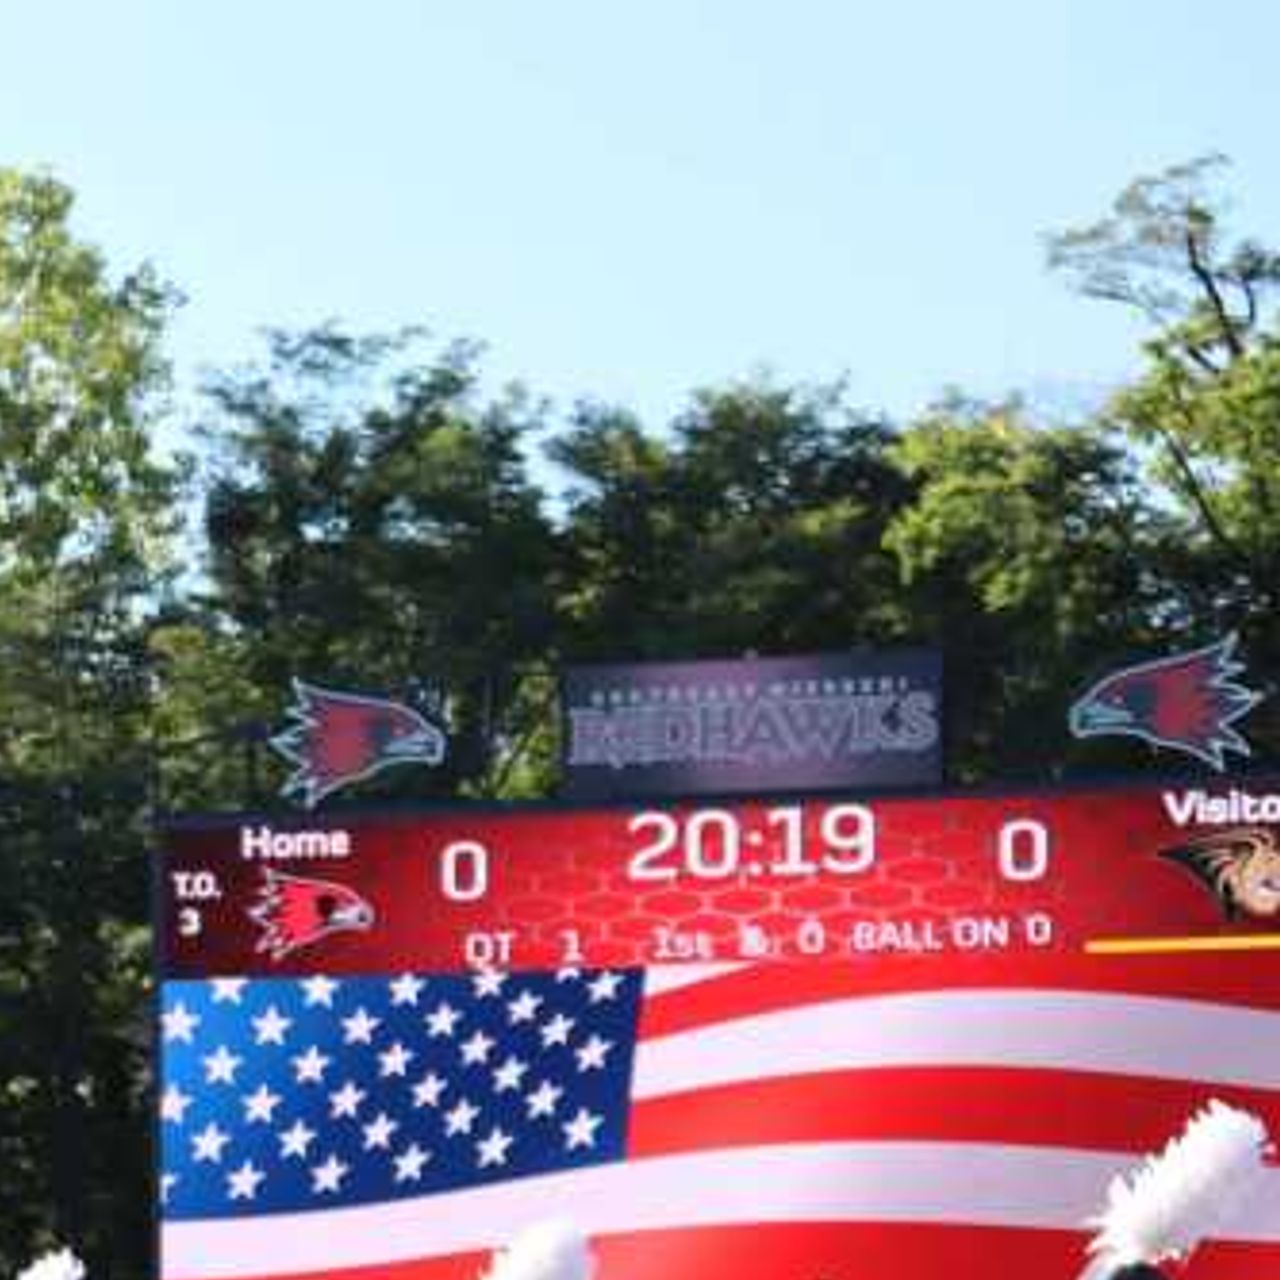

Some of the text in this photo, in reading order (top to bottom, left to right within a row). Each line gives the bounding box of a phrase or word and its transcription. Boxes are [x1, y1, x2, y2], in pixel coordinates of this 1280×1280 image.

[1162, 789, 1280, 826] Visito
[241, 827, 351, 858] Home
[627, 804, 877, 881] 20:19
[999, 819, 1048, 881] 0
[442, 841, 488, 901] 0
[178, 908, 201, 936] 3
[851, 920, 943, 951] BALL
[952, 916, 1008, 948] ON
